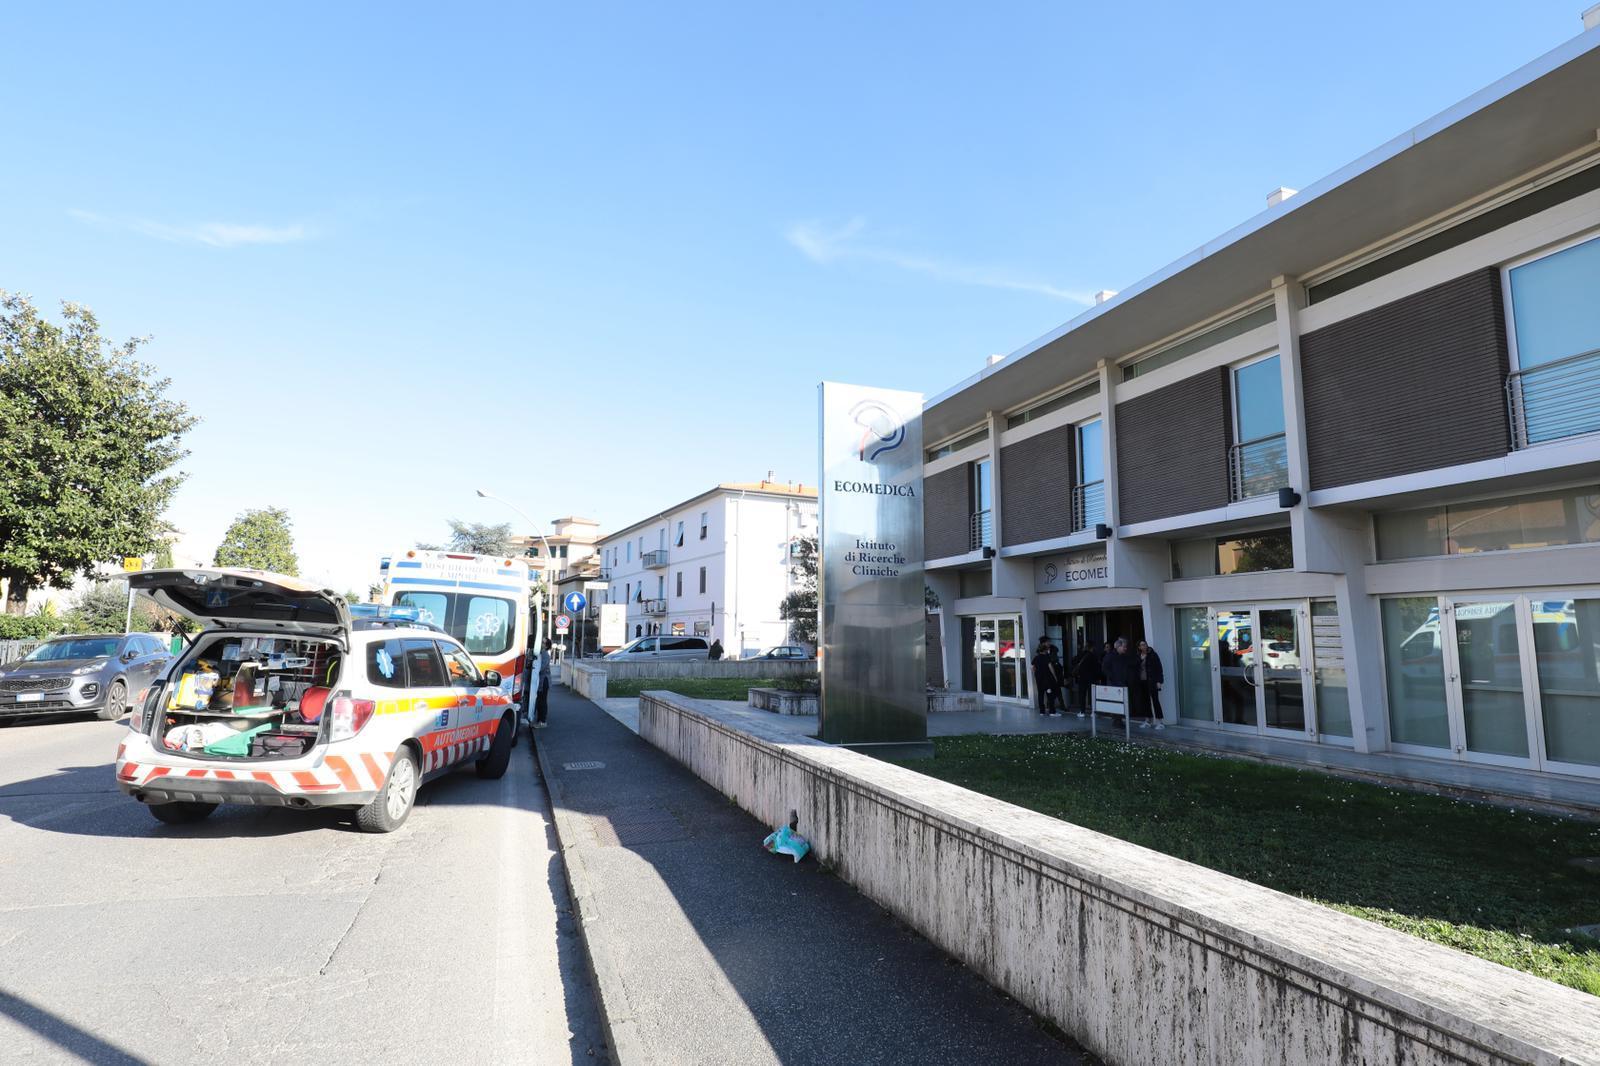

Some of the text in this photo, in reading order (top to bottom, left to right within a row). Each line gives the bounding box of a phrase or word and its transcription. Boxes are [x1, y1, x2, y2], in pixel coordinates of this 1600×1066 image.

[834, 480, 915, 497] ECOMEDICA
[856, 539, 896, 551] Istituto
[844, 551, 906, 564] di Ricerche
[852, 565, 899, 577] Cliniche
[1065, 567, 1108, 582] ECOME
[435, 726, 480, 747] AUTOMEDICA
